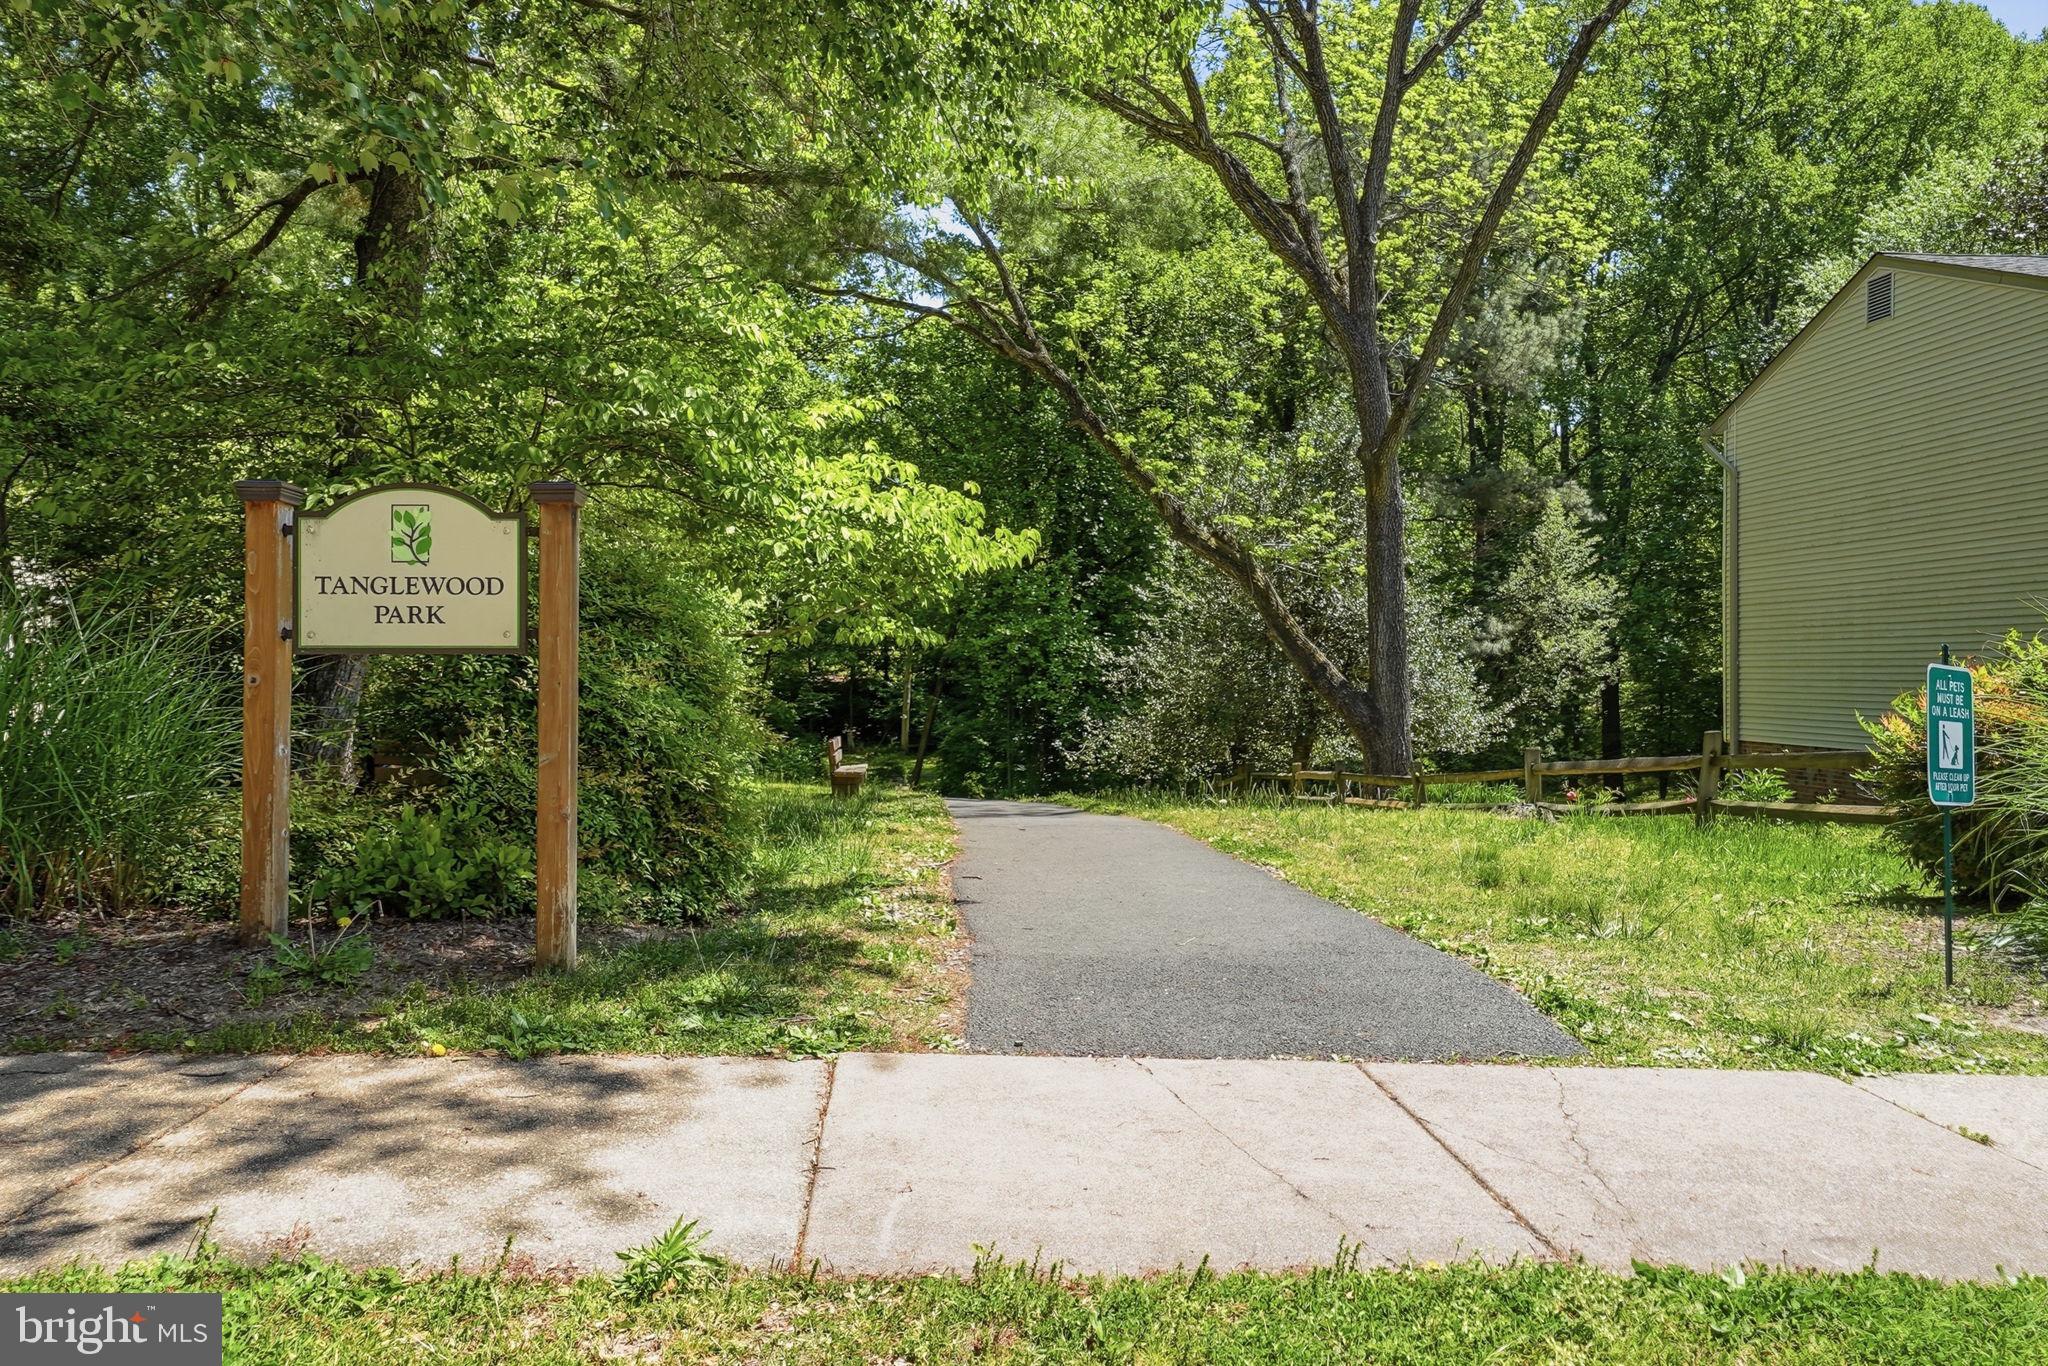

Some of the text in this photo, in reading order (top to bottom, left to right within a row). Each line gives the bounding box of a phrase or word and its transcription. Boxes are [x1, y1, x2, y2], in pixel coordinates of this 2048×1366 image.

[314, 576, 504, 596] TANGLEWOOD
[374, 605, 446, 625] PARK
[1935, 680, 1965, 693] ALL PETS
[1936, 692, 1964, 706] MUST BE
[1931, 705, 1970, 719] ON A LEASH
[1932, 771, 1949, 781] PLEASE
